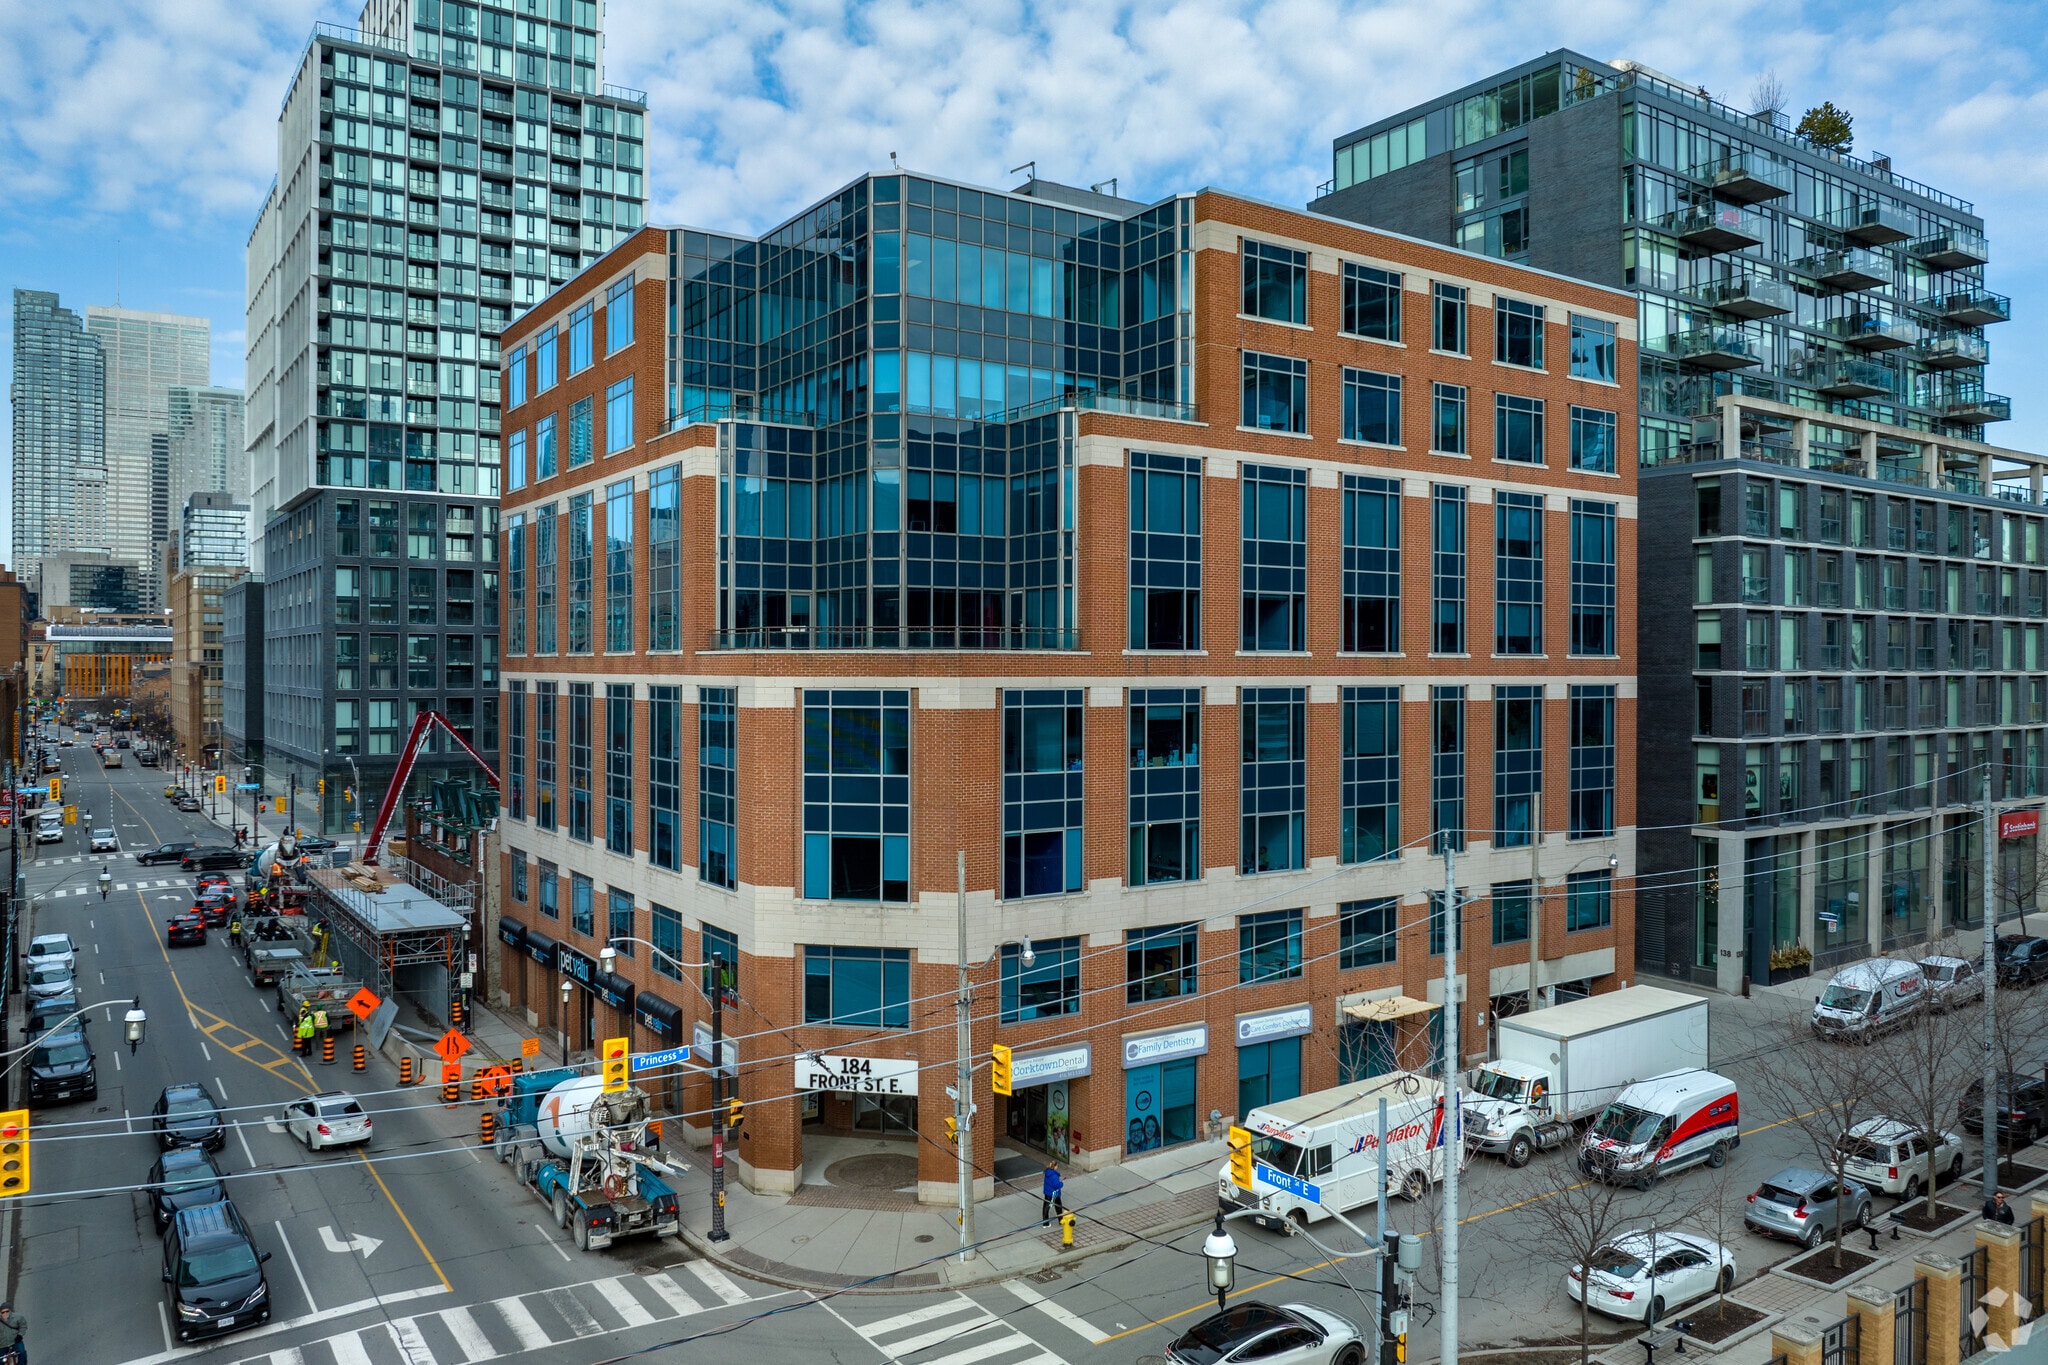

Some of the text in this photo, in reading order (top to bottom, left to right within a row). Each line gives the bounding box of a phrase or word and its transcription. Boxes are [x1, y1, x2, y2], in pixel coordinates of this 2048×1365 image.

[2009, 821, 2036, 832] Scotiabank
[1720, 949, 1731, 958] 138
[560, 950, 589, 982] pet valu
[1138, 1041, 1161, 1054] Family
[1163, 1037, 1196, 1049] Dentistry
[640, 1052, 677, 1067] Princess
[841, 1058, 872, 1075] 184
[809, 1073, 903, 1094] FRONT ST. E.
[1362, 1122, 1424, 1151] Puolator
[1267, 1170, 1291, 1189] Front
[1303, 1183, 1309, 1196] E
